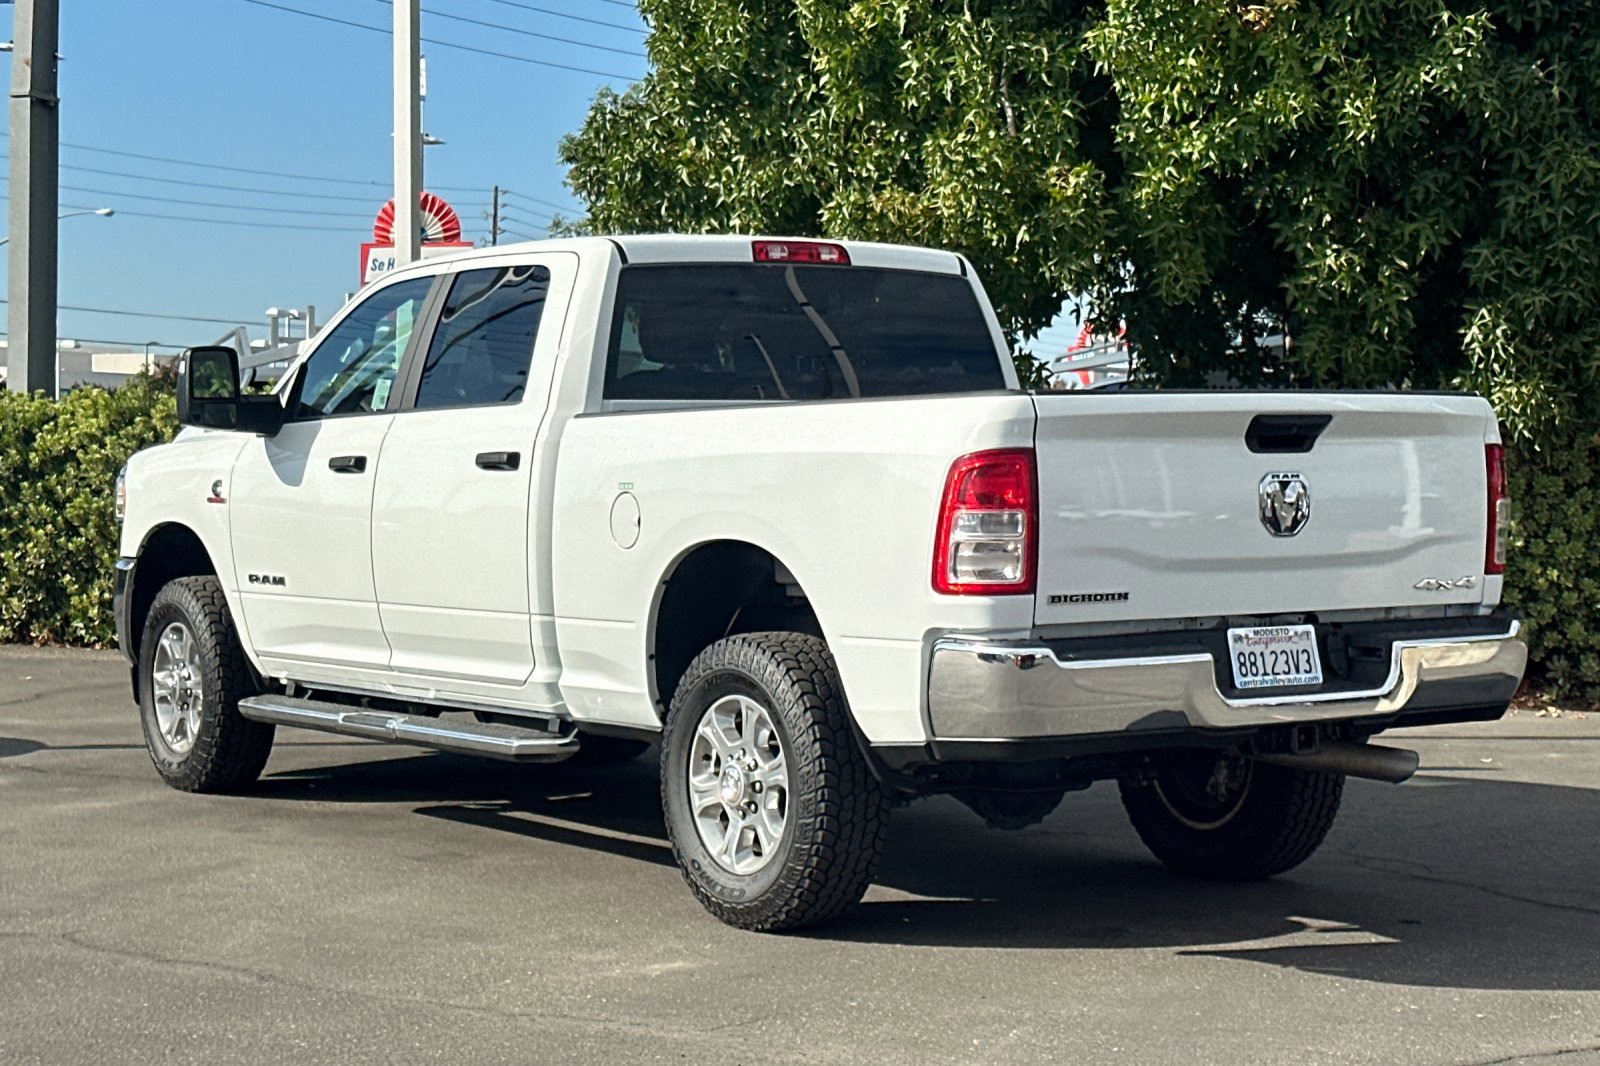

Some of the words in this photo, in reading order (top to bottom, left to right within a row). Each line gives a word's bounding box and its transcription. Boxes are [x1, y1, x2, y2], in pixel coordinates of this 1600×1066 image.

[370, 258, 385, 271] Se
[248, 574, 286, 587] RAM
[1047, 592, 1130, 605] BIGHORN
[1253, 628, 1290, 636] MODESTO
[1237, 649, 1312, 677] 88123V3
[1240, 675, 1320, 688] centralvalleyauto.com
